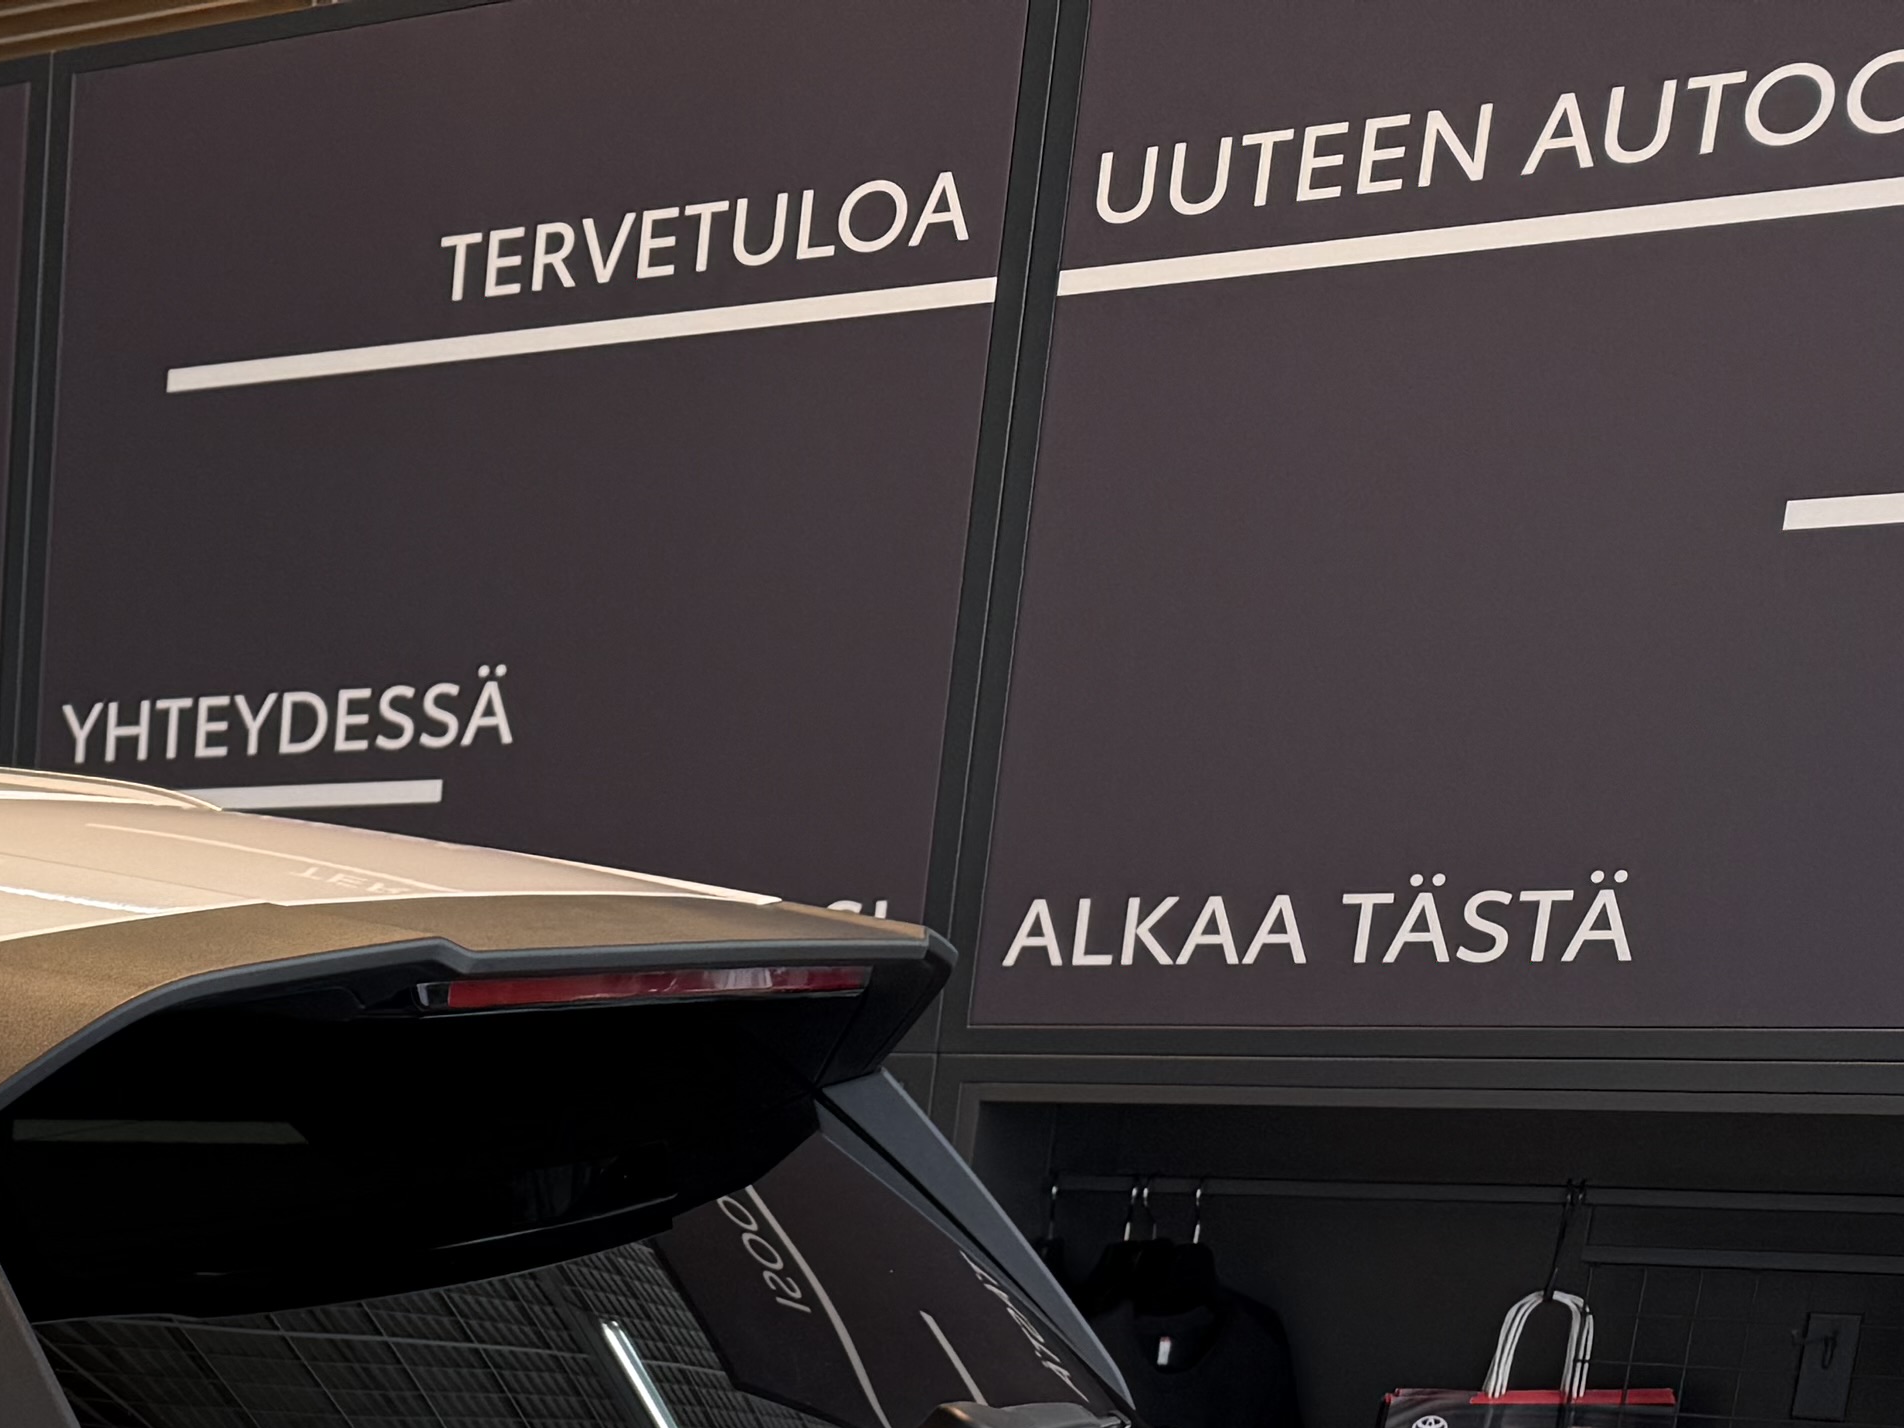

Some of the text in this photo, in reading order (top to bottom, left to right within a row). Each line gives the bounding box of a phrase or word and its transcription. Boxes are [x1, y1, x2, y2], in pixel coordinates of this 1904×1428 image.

[1094, 104, 1495, 224] UUTEEN
[441, 172, 970, 302] TERVETULOA
[63, 664, 514, 766] YHTEYDESSÄ
[1003, 869, 1633, 968] ALKAA TÄSTÄ
